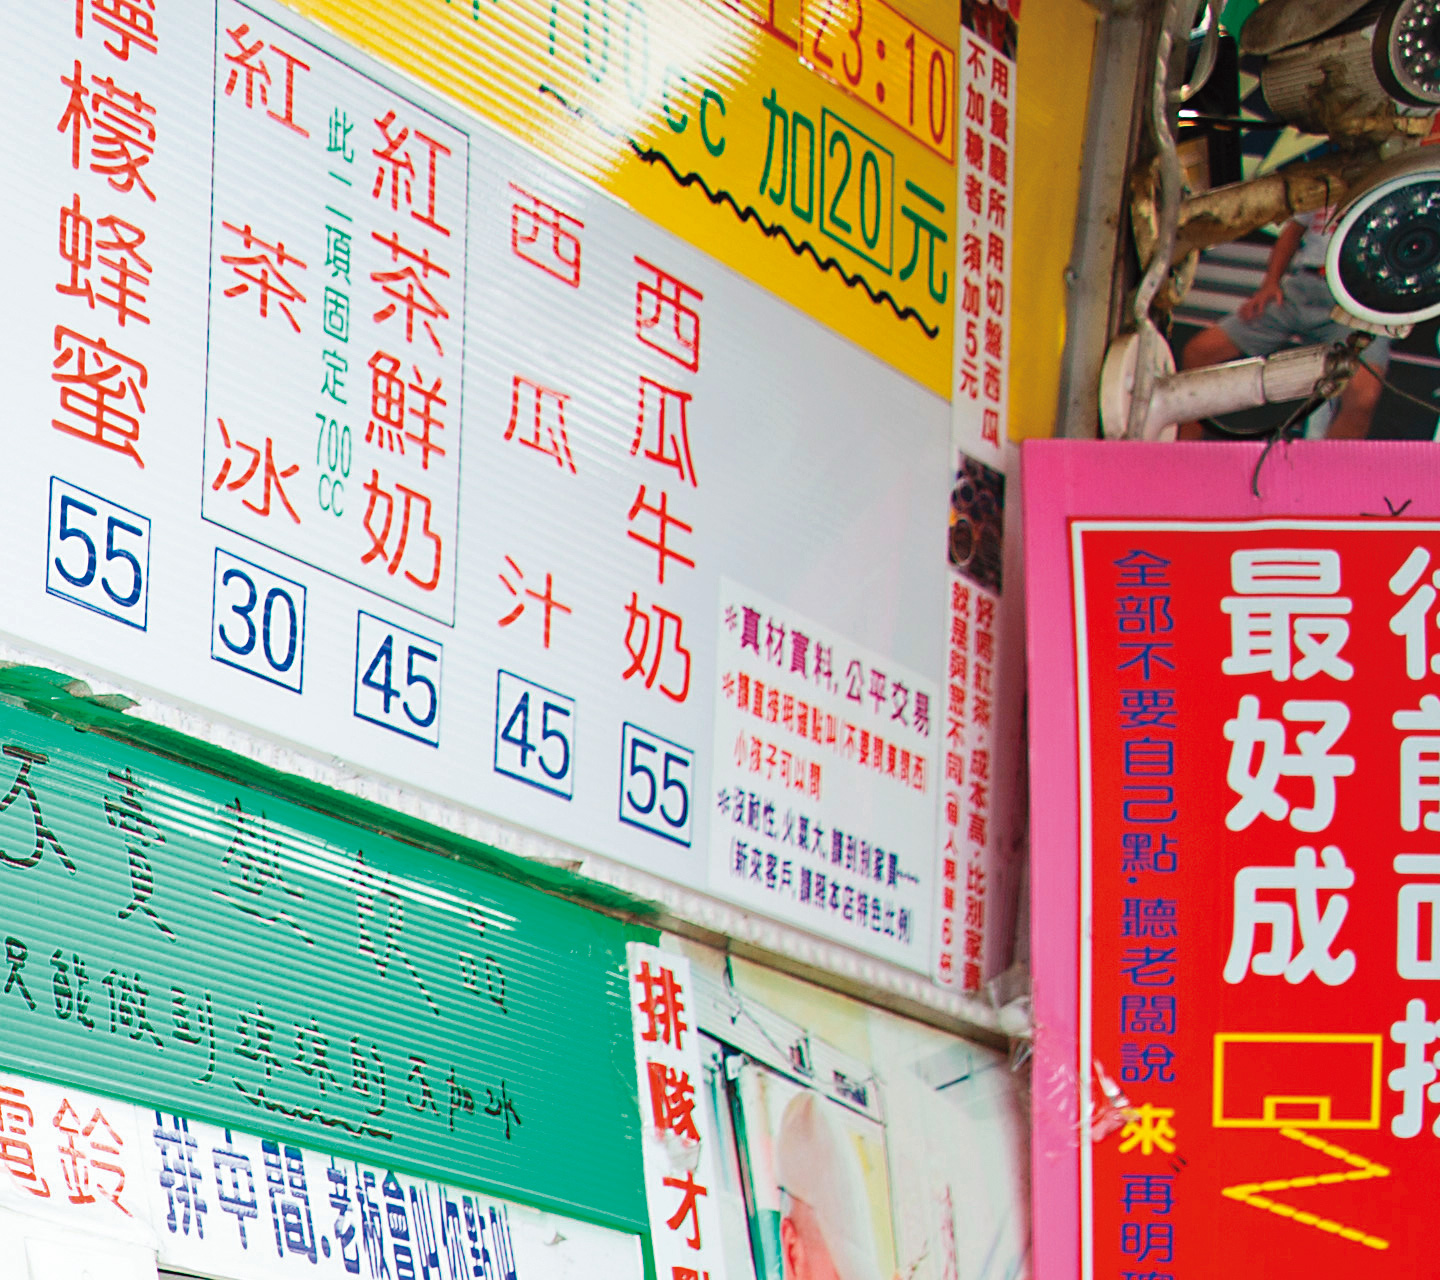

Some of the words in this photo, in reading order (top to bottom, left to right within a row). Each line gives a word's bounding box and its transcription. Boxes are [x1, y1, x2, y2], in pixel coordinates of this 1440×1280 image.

[212, 22, 312, 526] 紅茶冰
[361, 108, 453, 594] 紅茶鮮奶
[498, 180, 586, 650] 西瓜汁
[623, 254, 705, 707] 西瓜牛奶
[54, 502, 144, 612] 55
[217, 567, 298, 676] 30
[362, 634, 438, 729] 45
[500, 707, 572, 783] 45
[626, 761, 692, 833] 55
[1220, 546, 1357, 987] 最好成
[1117, 1101, 1177, 1157] 來
